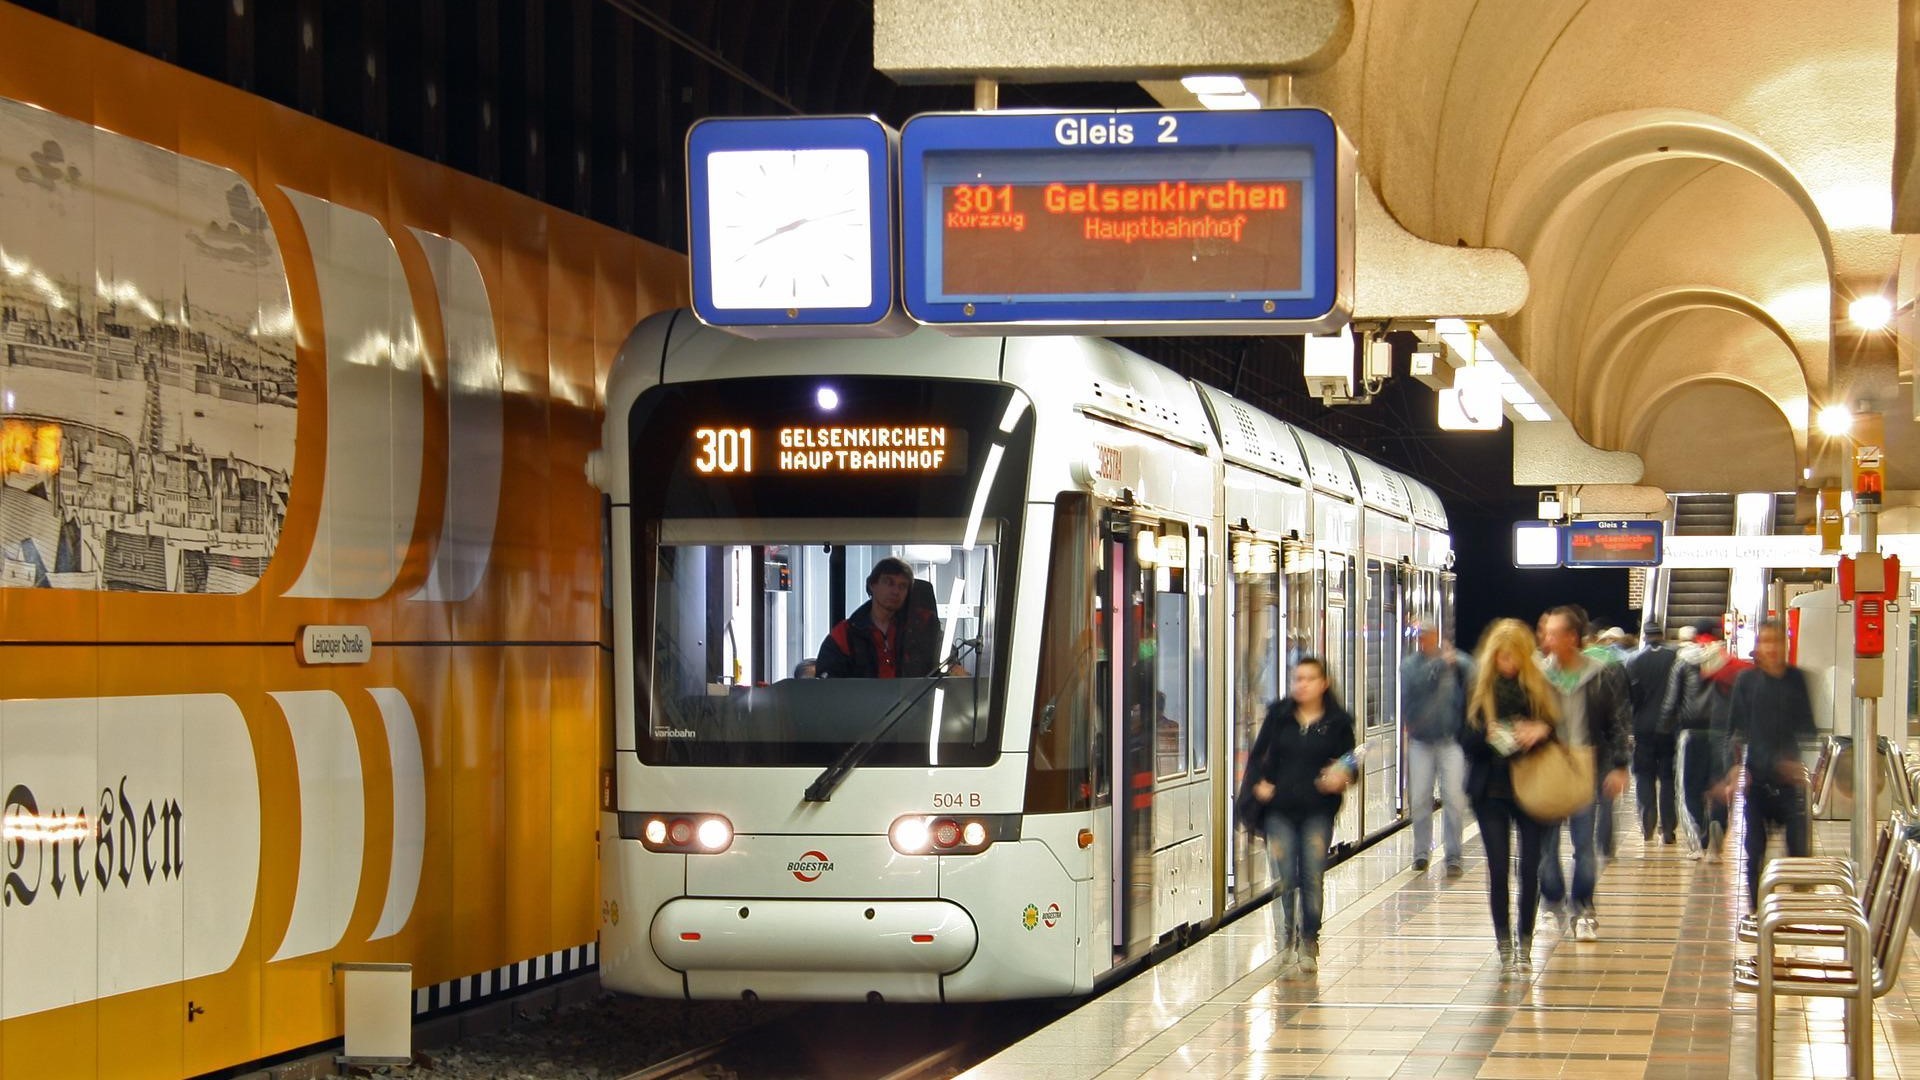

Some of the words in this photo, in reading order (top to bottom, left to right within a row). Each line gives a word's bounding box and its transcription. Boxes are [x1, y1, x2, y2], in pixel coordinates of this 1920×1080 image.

[1055, 117, 1134, 146] Gleis
[1157, 115, 1179, 143] 2
[953, 184, 1013, 213] 301
[1045, 180, 1287, 212] Gelsenkirchen
[947, 212, 1025, 232] Kurzzug
[1085, 214, 1246, 243] Hauptbahnhof
[780, 428, 945, 447] GELSENKIRCHEN
[696, 428, 752, 472] 301
[780, 450, 945, 470] HAUPTBAHNHOF
[1598, 521, 1617, 529] Gleis
[1622, 521, 1628, 529] 2
[312, 634, 341, 658] Leipziger
[342, 634, 364, 654] Straße
[654, 728, 696, 738] variobahn
[933, 793, 964, 808] 504
[969, 793, 981, 807] B
[4, 775, 184, 907] Dresden
[787, 862, 834, 871] BOGESTRA
